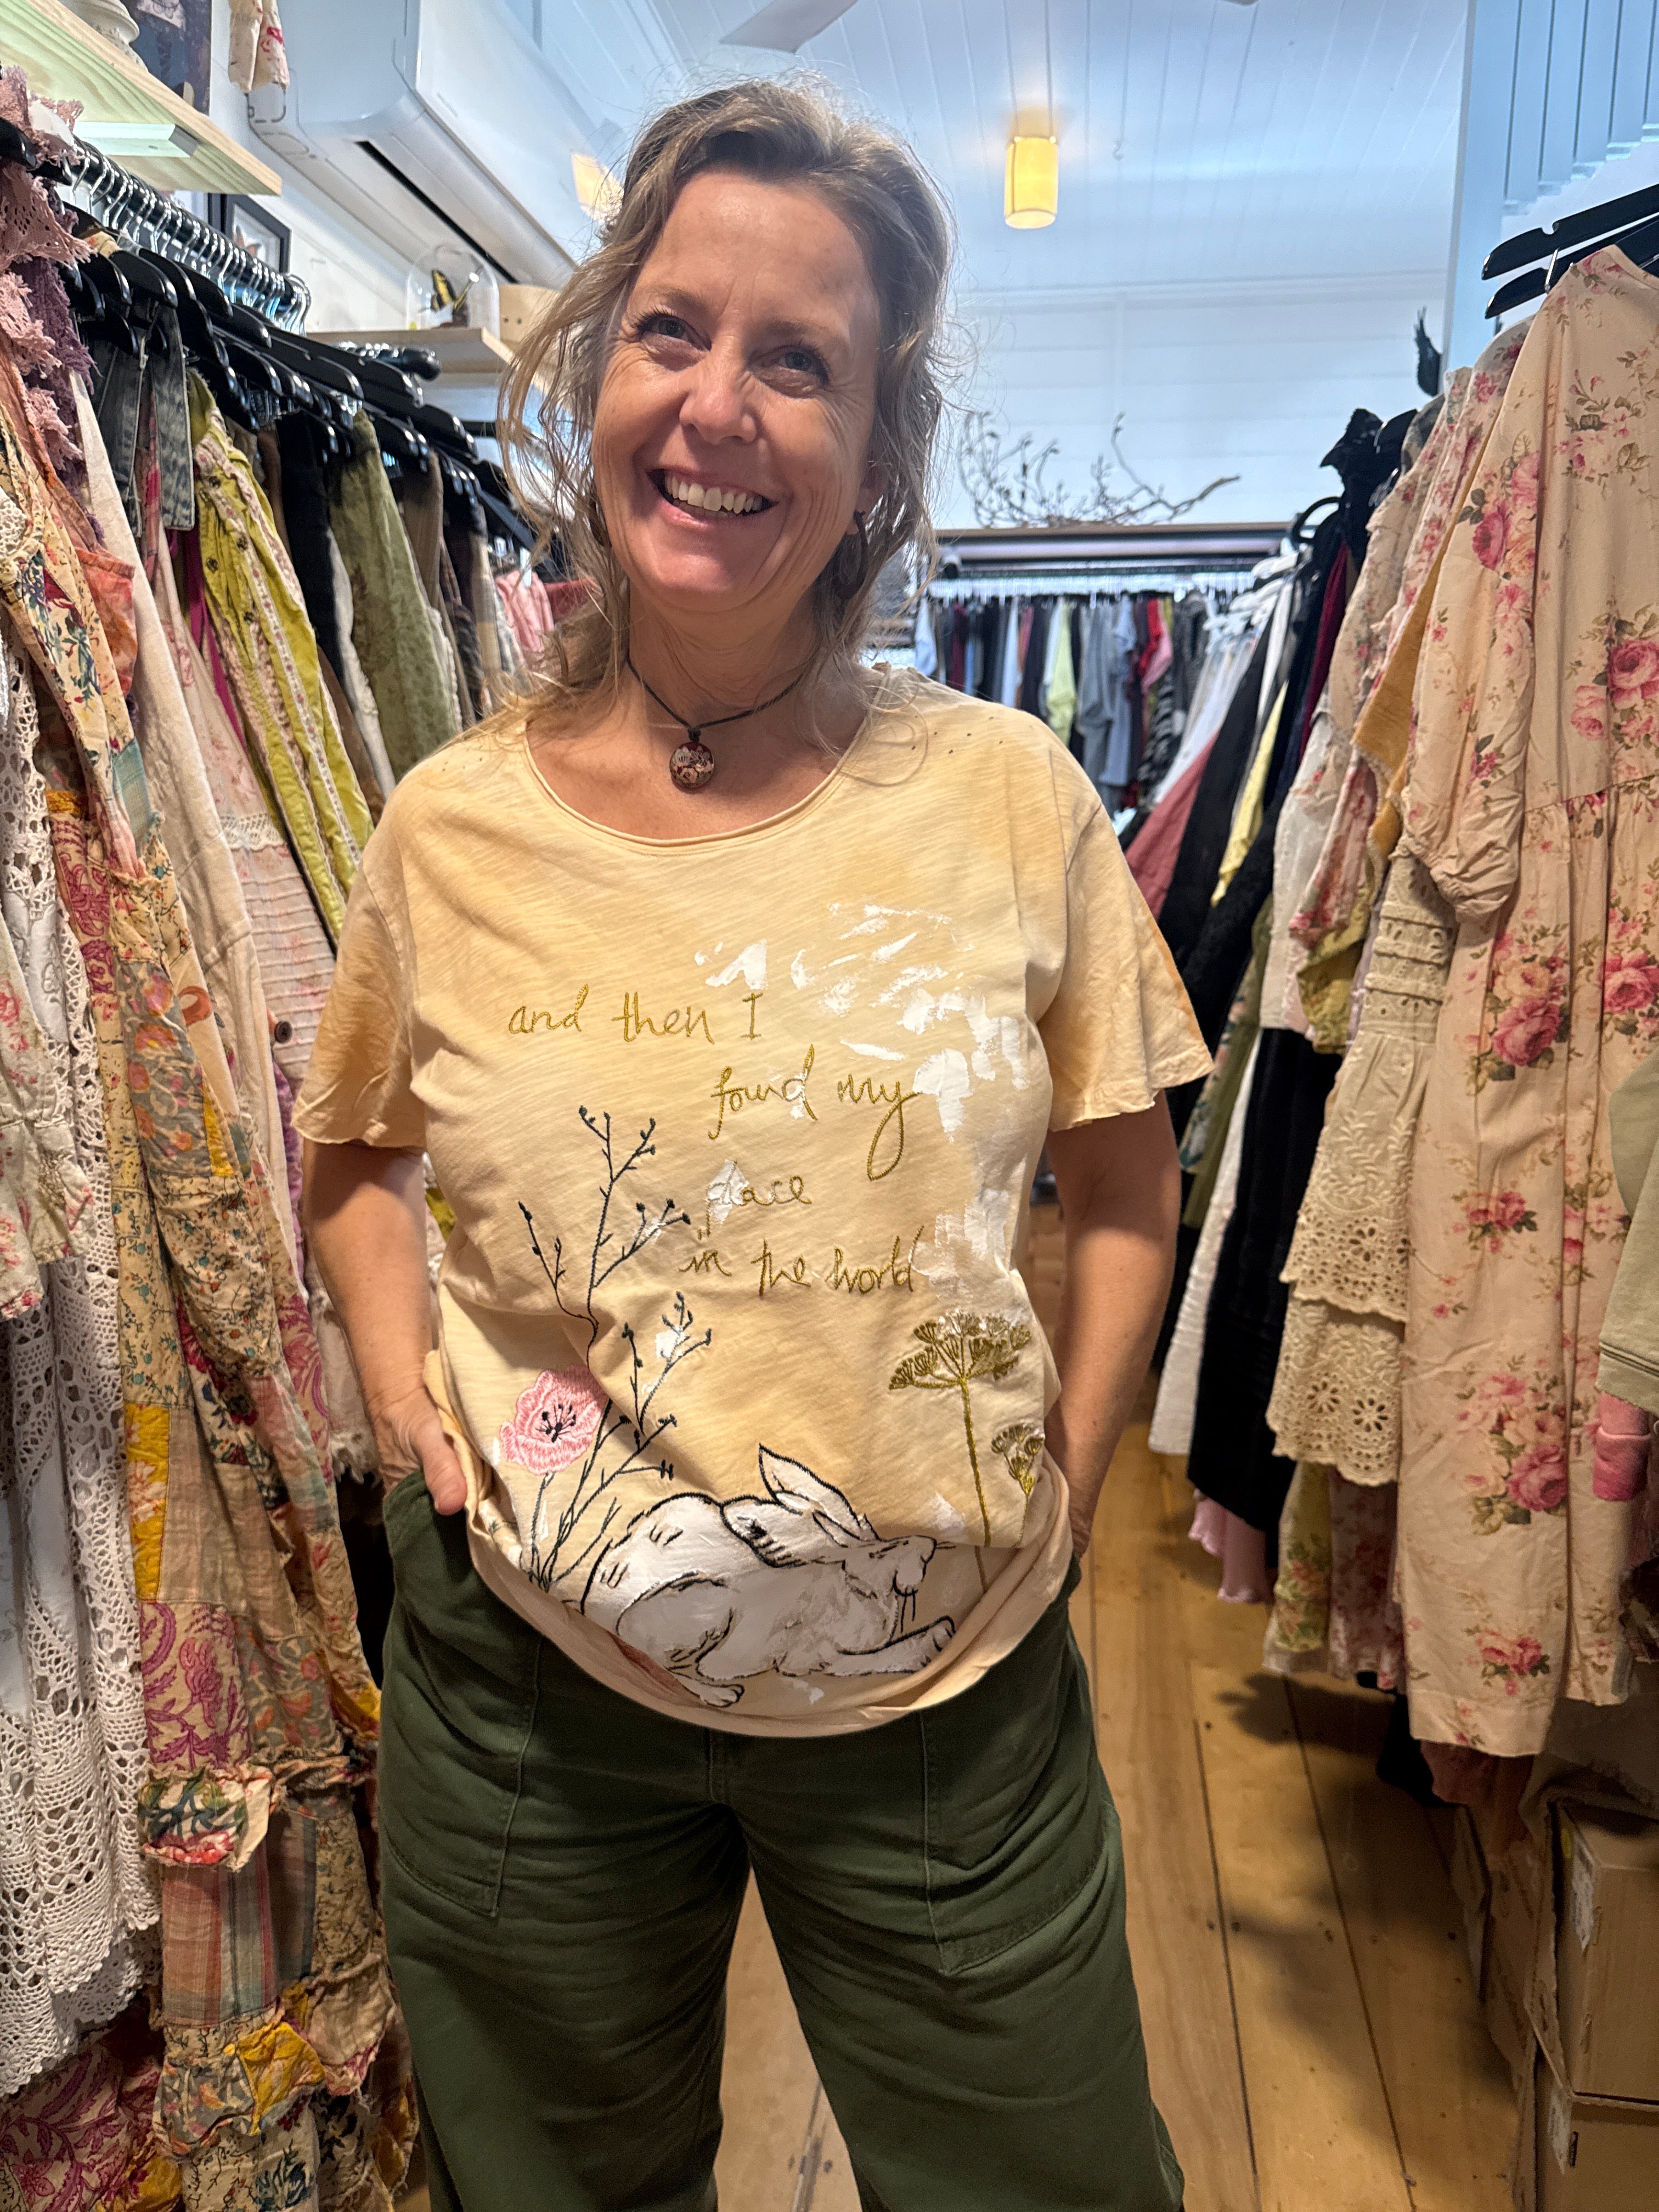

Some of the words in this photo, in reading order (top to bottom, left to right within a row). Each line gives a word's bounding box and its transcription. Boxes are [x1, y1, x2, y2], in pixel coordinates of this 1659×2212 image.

[509, 984, 588, 1035] and
[612, 992, 714, 1044] then
[741, 992, 763, 1040] I
[708, 1044, 817, 1139] found
[837, 1074, 922, 1181] my
[698, 1160, 811, 1240] place
[680, 1250, 732, 1276] in
[752, 1239, 811, 1297] the
[825, 1226, 924, 1294] world
